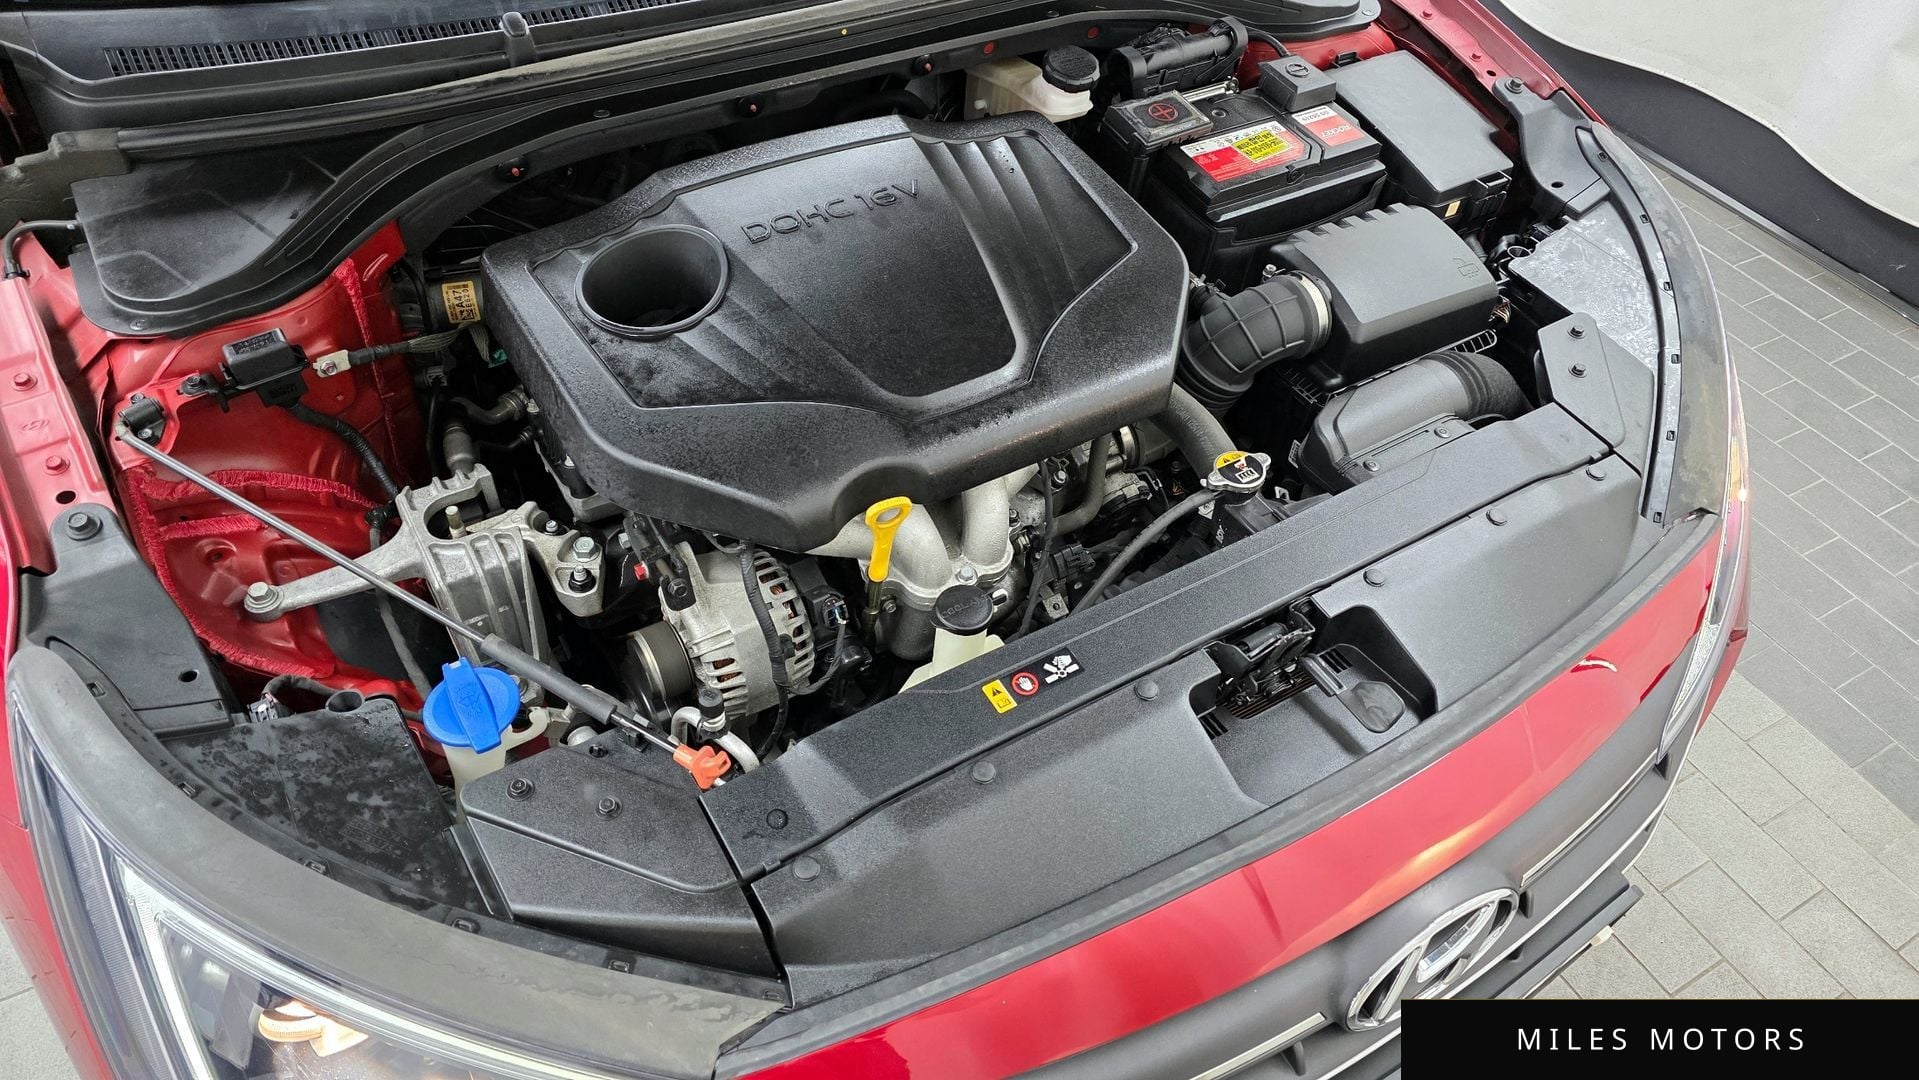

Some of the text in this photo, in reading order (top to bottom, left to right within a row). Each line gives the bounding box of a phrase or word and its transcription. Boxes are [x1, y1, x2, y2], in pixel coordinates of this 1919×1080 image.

[1320, 124, 1352, 138] ROCKET
[740, 178, 919, 245] DOHC 16V
[452, 289, 466, 309] A47
